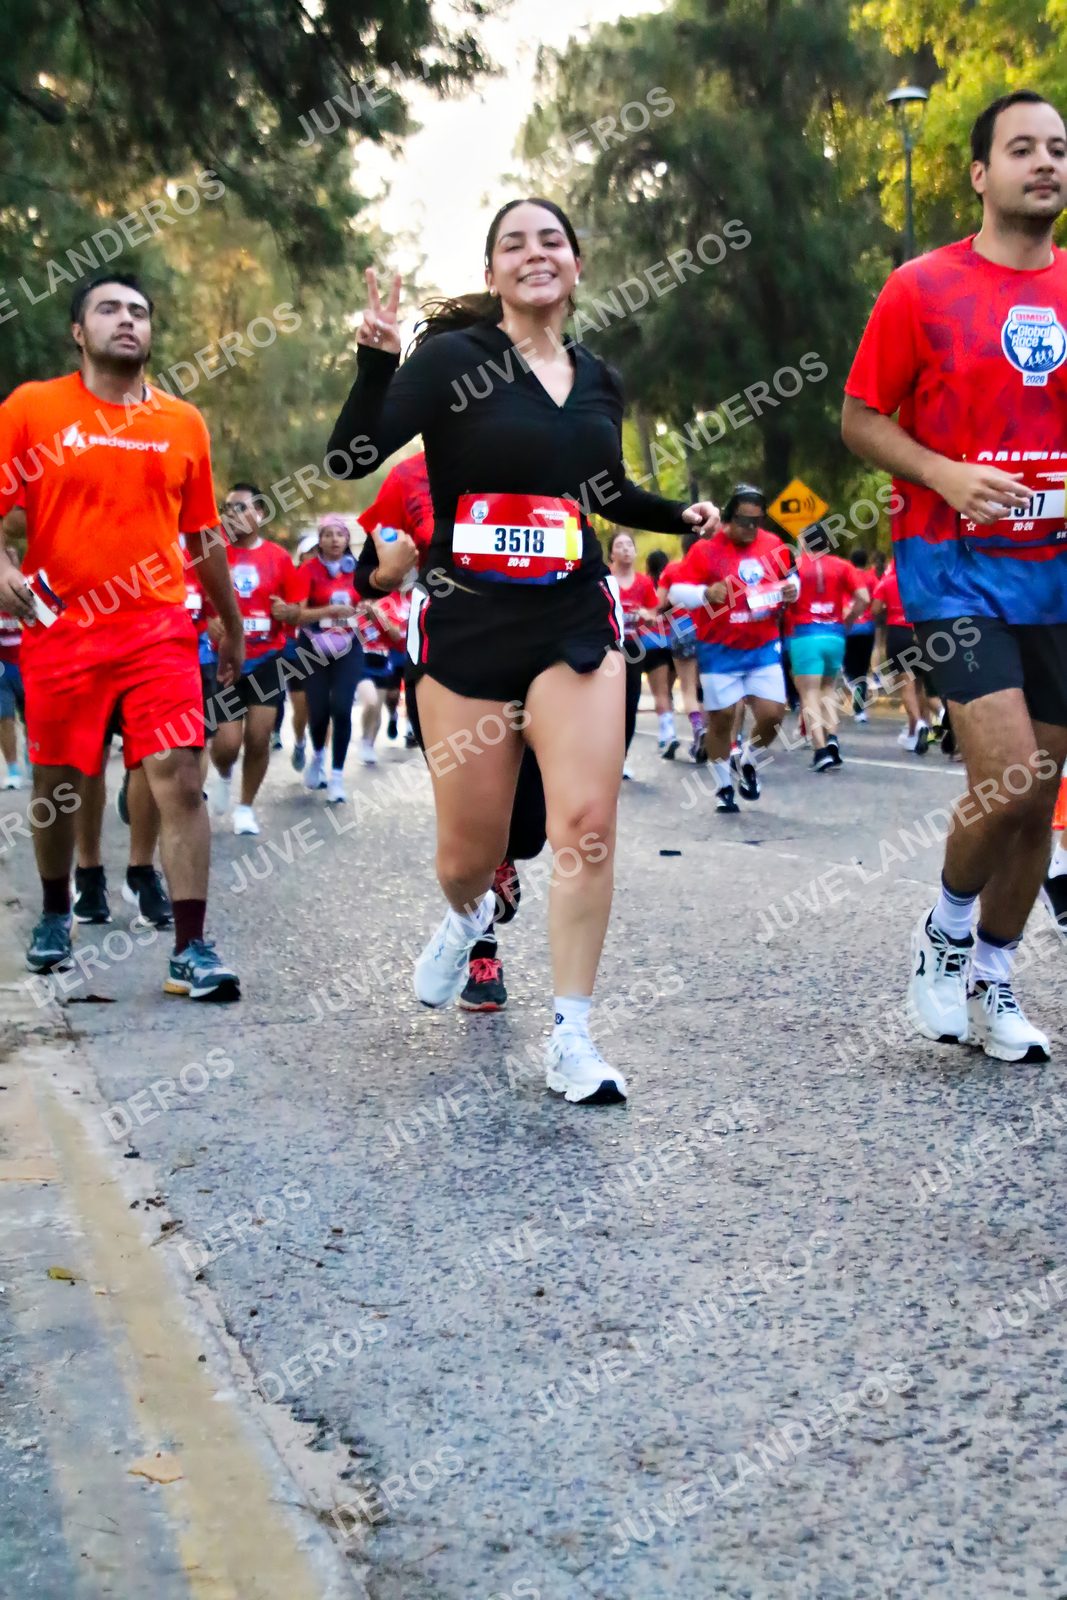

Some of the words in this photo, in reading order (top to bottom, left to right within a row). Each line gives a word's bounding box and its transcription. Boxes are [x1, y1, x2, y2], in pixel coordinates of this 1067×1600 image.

[1017, 325, 1052, 338] Global
[1011, 335, 1039, 347] Race
[494, 527, 545, 554] 3518
